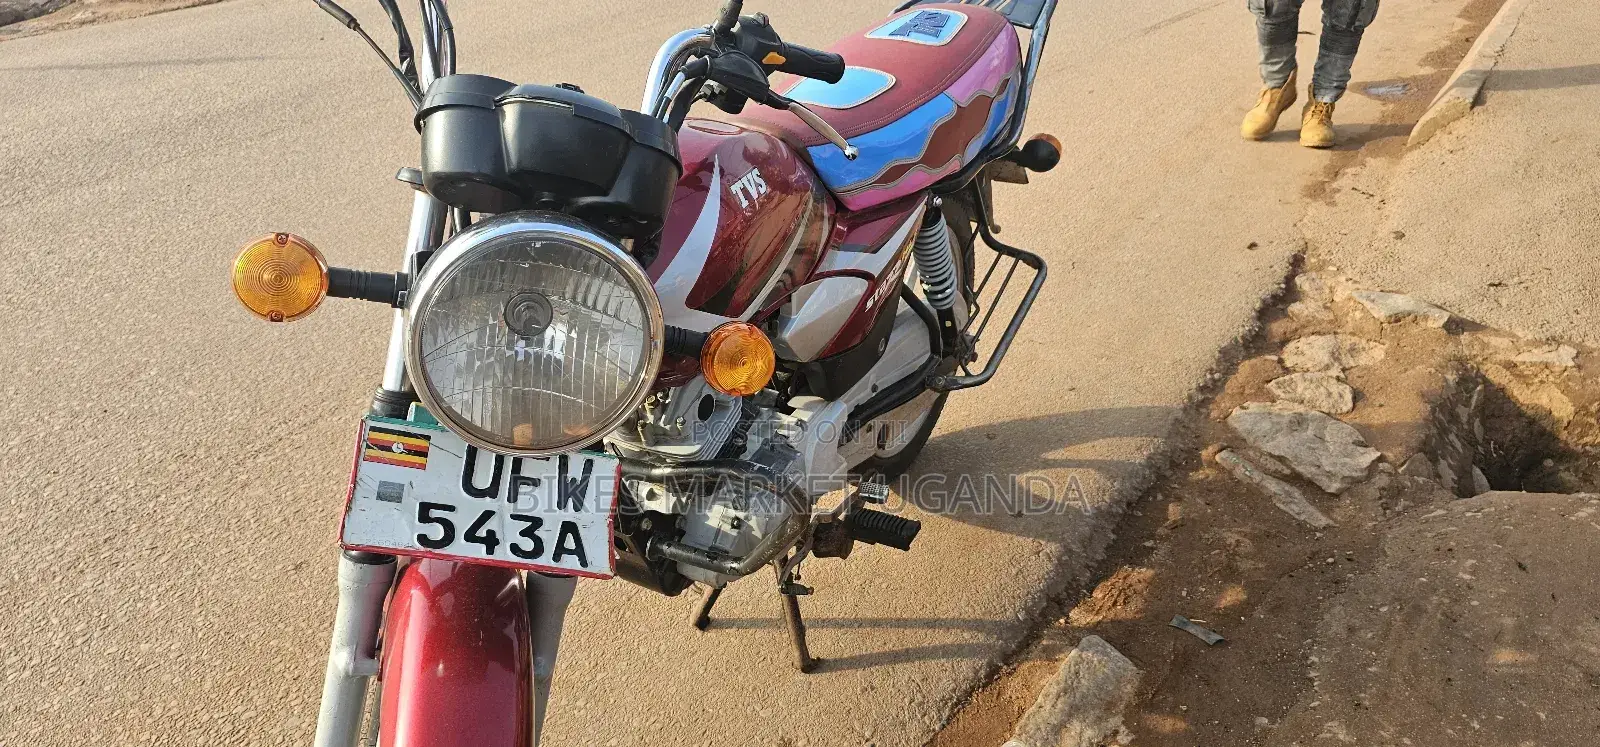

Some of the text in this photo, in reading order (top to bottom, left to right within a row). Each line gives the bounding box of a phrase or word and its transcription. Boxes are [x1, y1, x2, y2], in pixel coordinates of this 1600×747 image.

[730, 168, 767, 209] TVS
[462, 443, 594, 512] UFW
[416, 502, 588, 568] 543A
